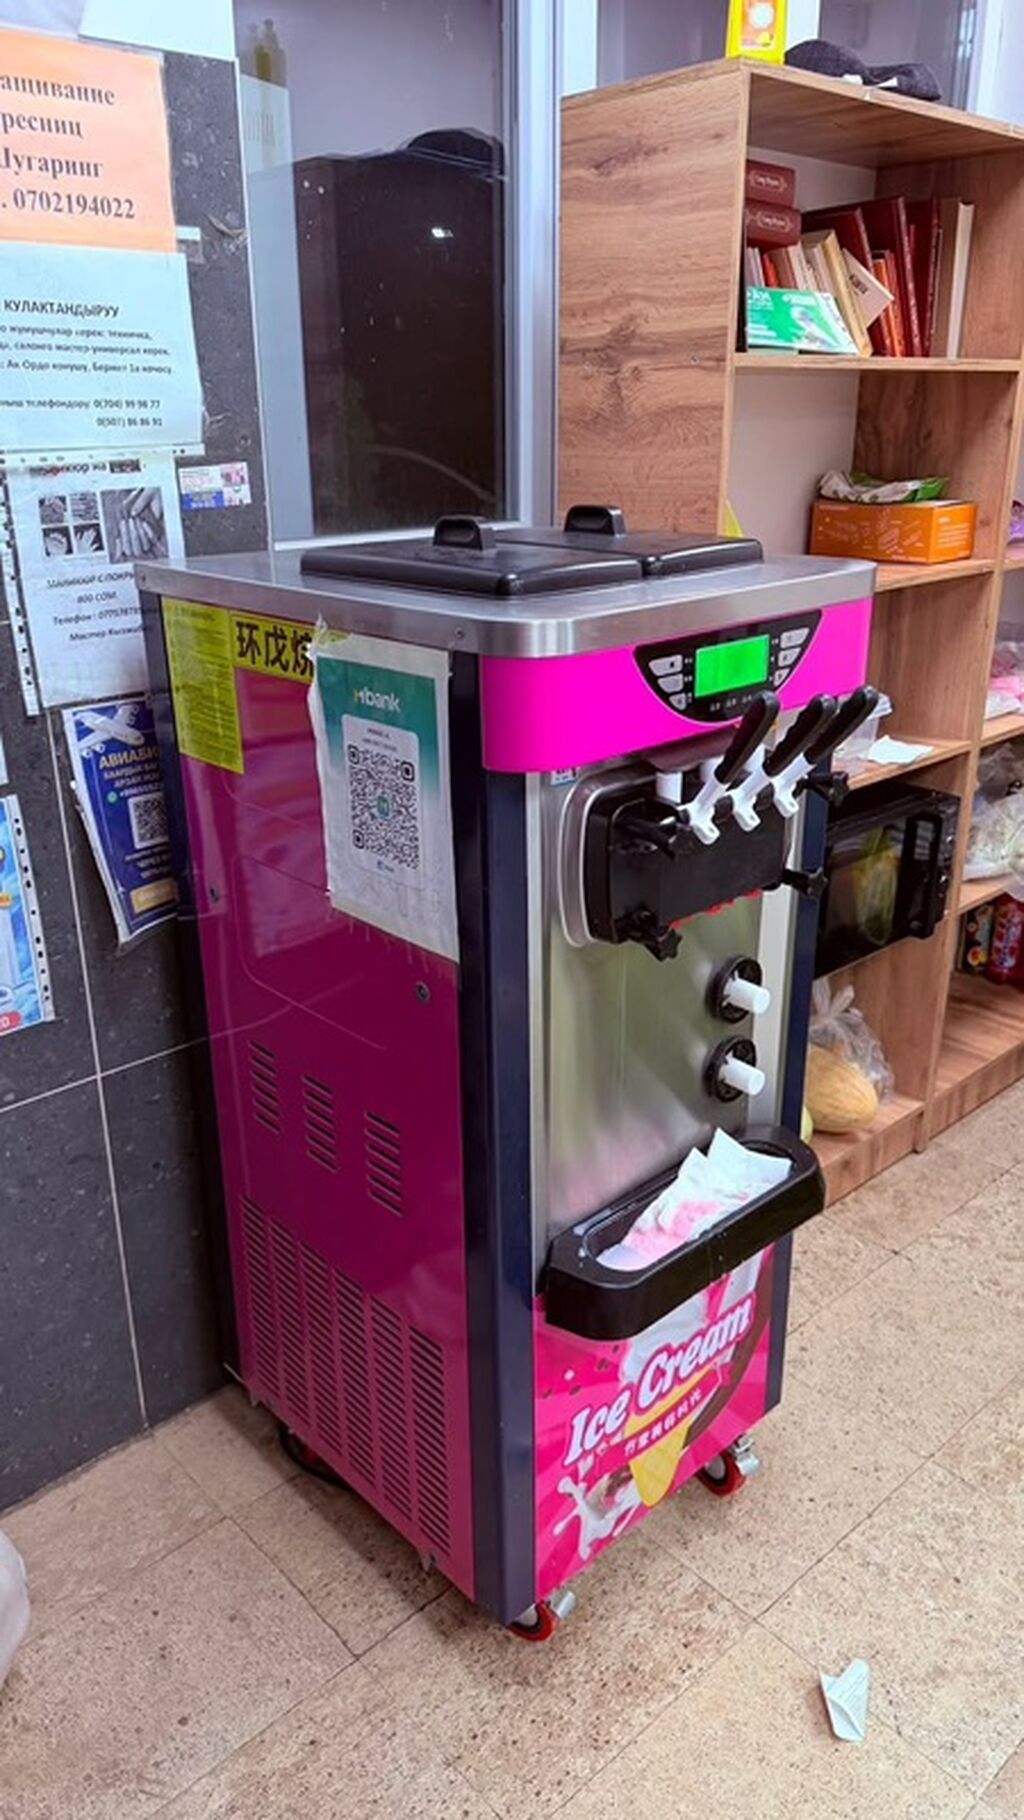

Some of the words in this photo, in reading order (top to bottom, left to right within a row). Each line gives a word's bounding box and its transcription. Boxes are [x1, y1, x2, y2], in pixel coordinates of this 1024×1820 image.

[13, 187, 136, 219] 0702194022
[564, 1389, 632, 1466] Ice
[637, 1297, 753, 1409] Cream
